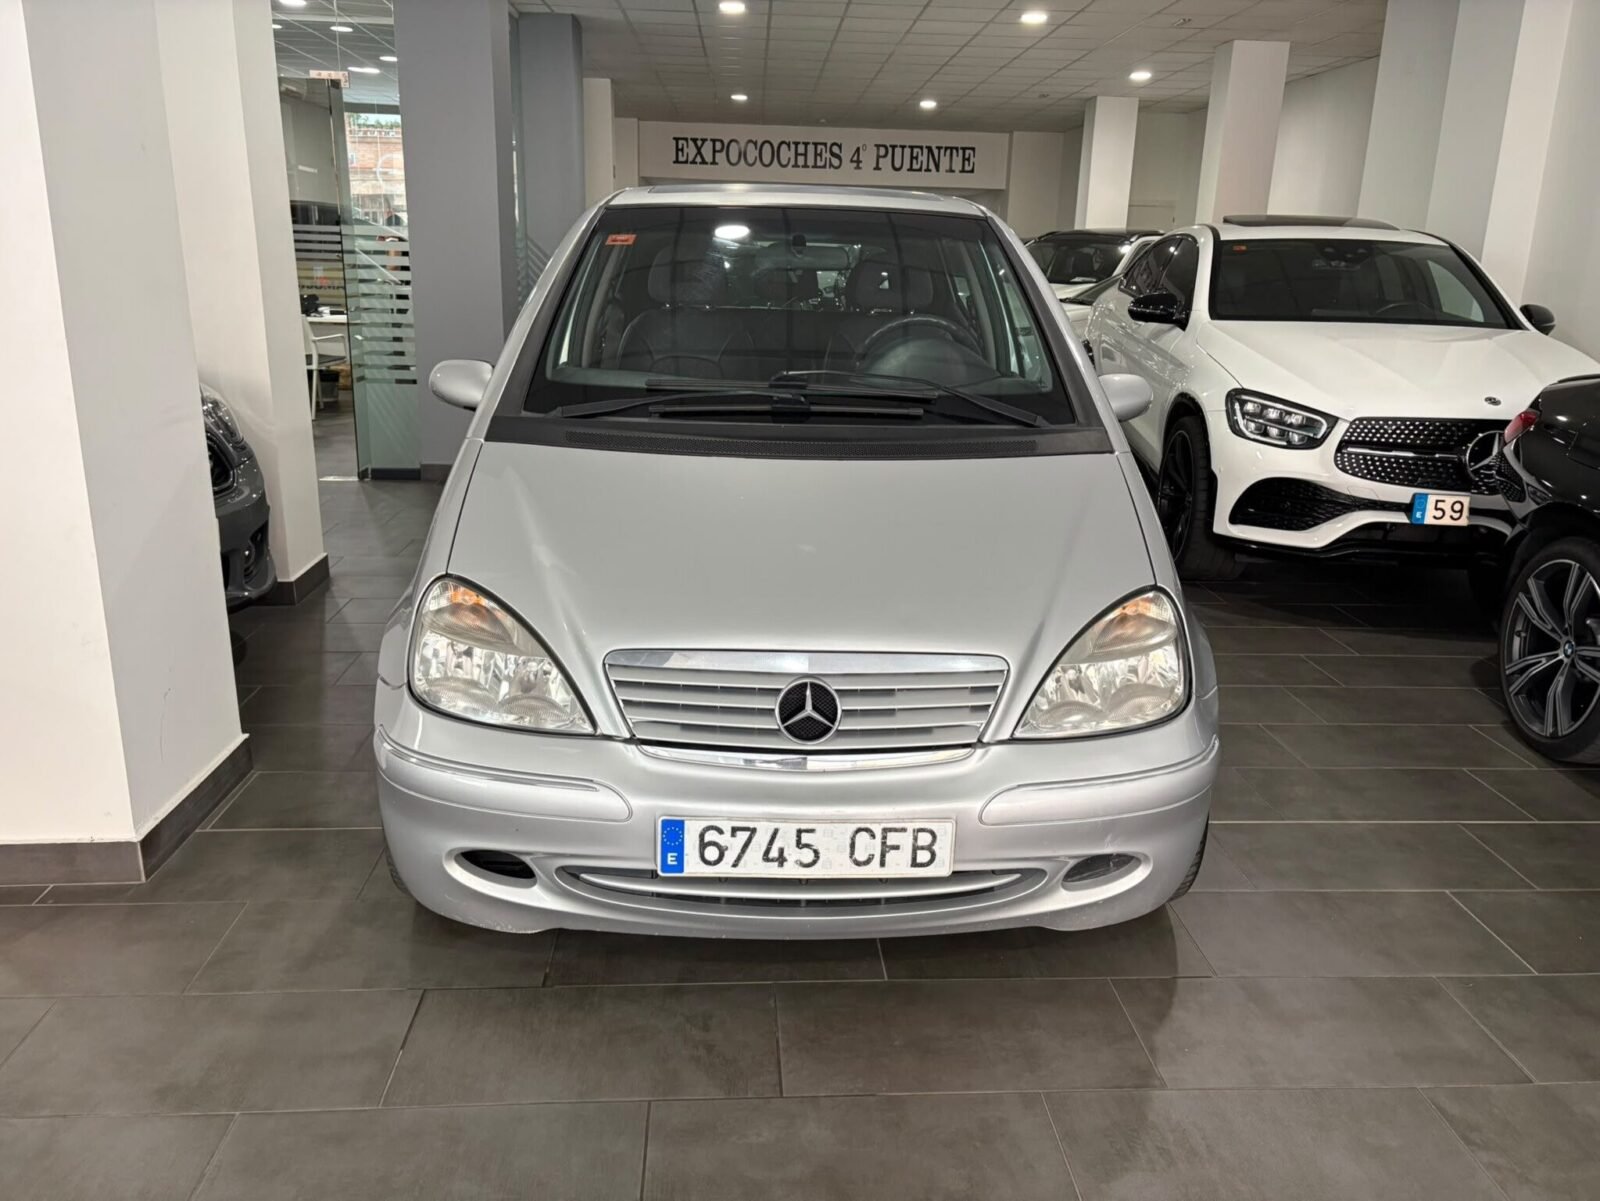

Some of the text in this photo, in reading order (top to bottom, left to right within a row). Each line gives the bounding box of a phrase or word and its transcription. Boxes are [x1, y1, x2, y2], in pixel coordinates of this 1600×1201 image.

[672, 136, 843, 170] EXPOCOCHES
[873, 143, 976, 174] PUENTE
[1432, 499, 1465, 521] 59
[667, 825, 938, 868] E 6745 CFB
